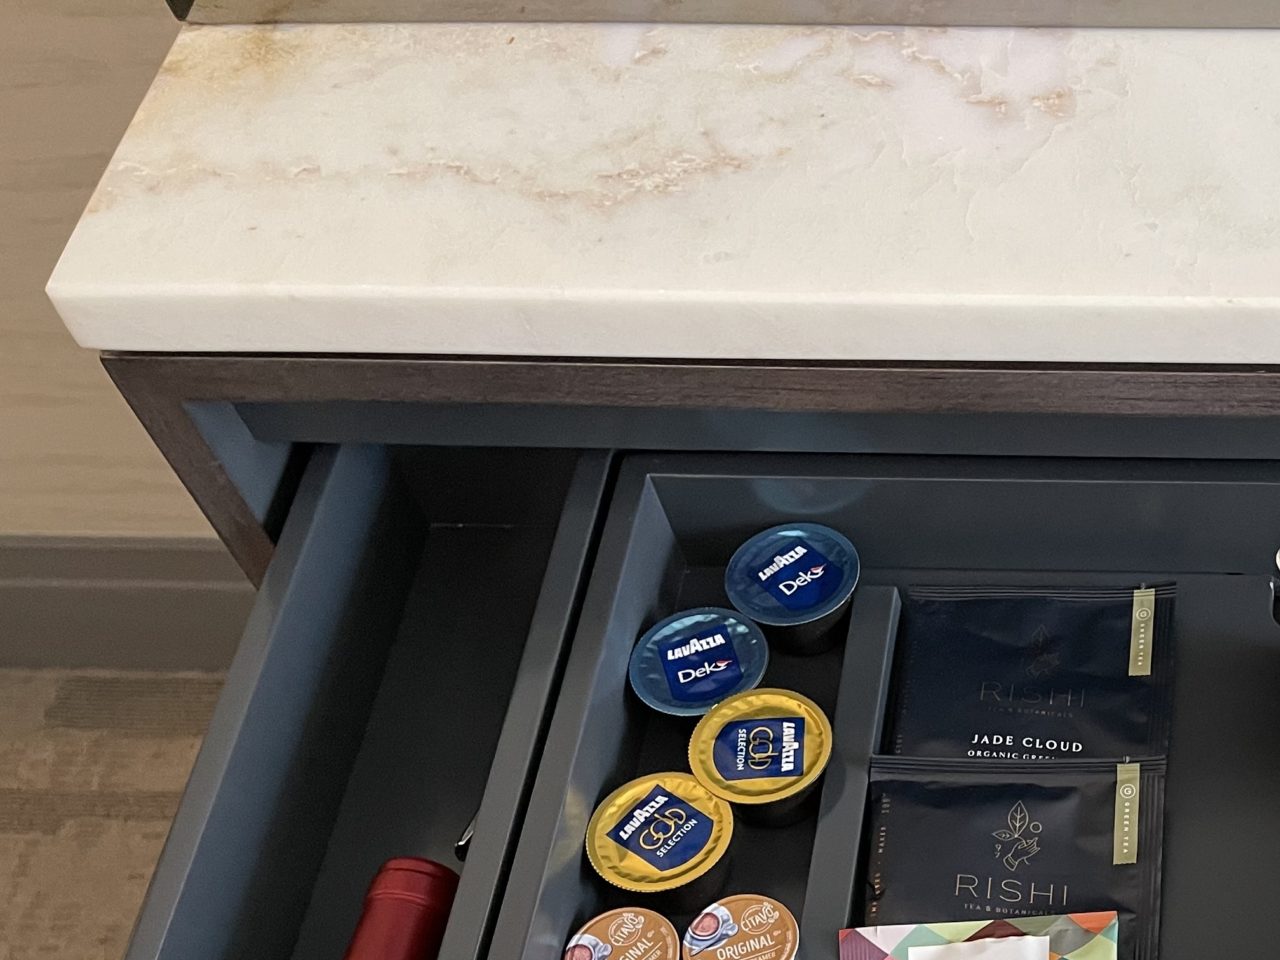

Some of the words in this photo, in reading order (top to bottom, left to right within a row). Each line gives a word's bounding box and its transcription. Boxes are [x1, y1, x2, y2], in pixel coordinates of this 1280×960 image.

[758, 545, 808, 582] LAVAZZA
[667, 633, 726, 661] LAVAZZA
[980, 681, 1085, 708] RISHI
[736, 728, 747, 771] SELECTION
[781, 721, 799, 772] LAVAZZA
[967, 749, 1018, 759] ORGANIC
[971, 734, 1014, 746] JADE
[1022, 737, 1083, 752] CLOUD
[619, 795, 668, 840] LAVAZZA
[656, 818, 698, 858] SELECTION
[955, 873, 1068, 906] RISHI
[741, 904, 774, 931] CITAVO
[717, 934, 775, 960] ORIGINAL
